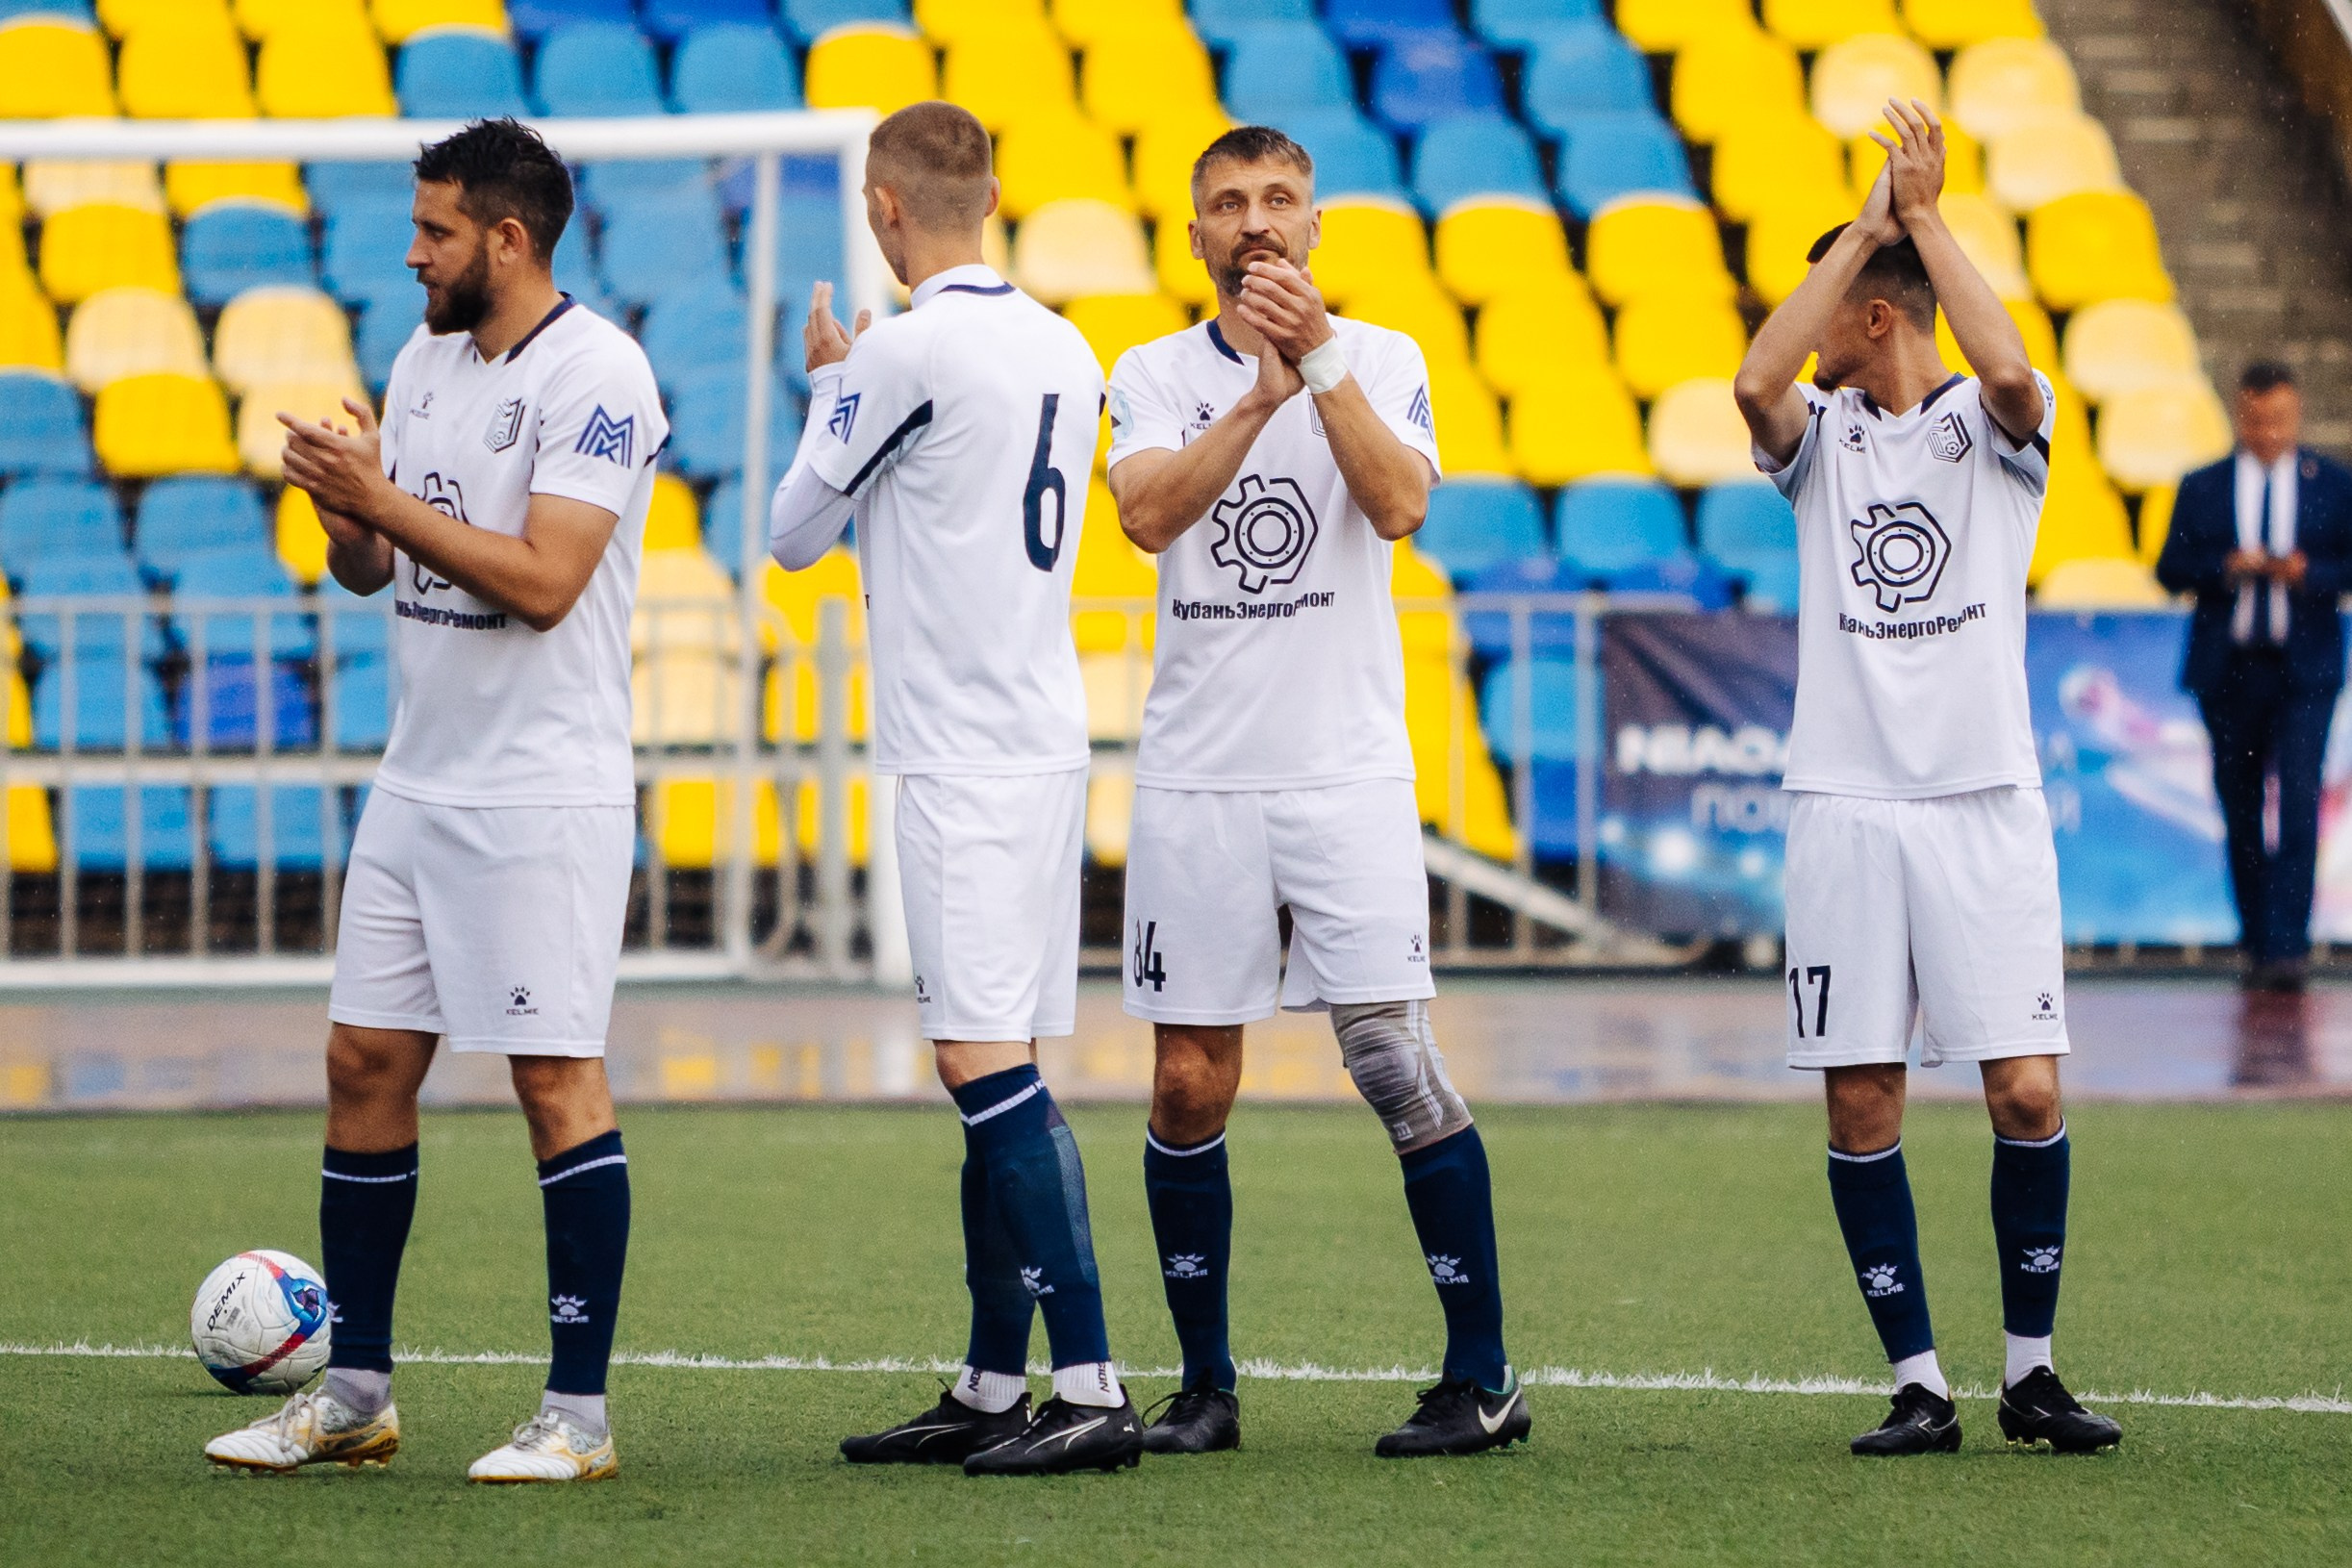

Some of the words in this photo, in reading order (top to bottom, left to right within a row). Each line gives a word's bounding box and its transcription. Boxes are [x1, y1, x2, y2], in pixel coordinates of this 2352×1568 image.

[1024, 393, 1065, 571] 6
[1134, 917, 1166, 992] 84
[1788, 965, 1831, 1038] 17
[1867, 1282, 1904, 1298] KELME
[2021, 1261, 2060, 1273] KELME
[207, 1272, 245, 1331] DEMIX
